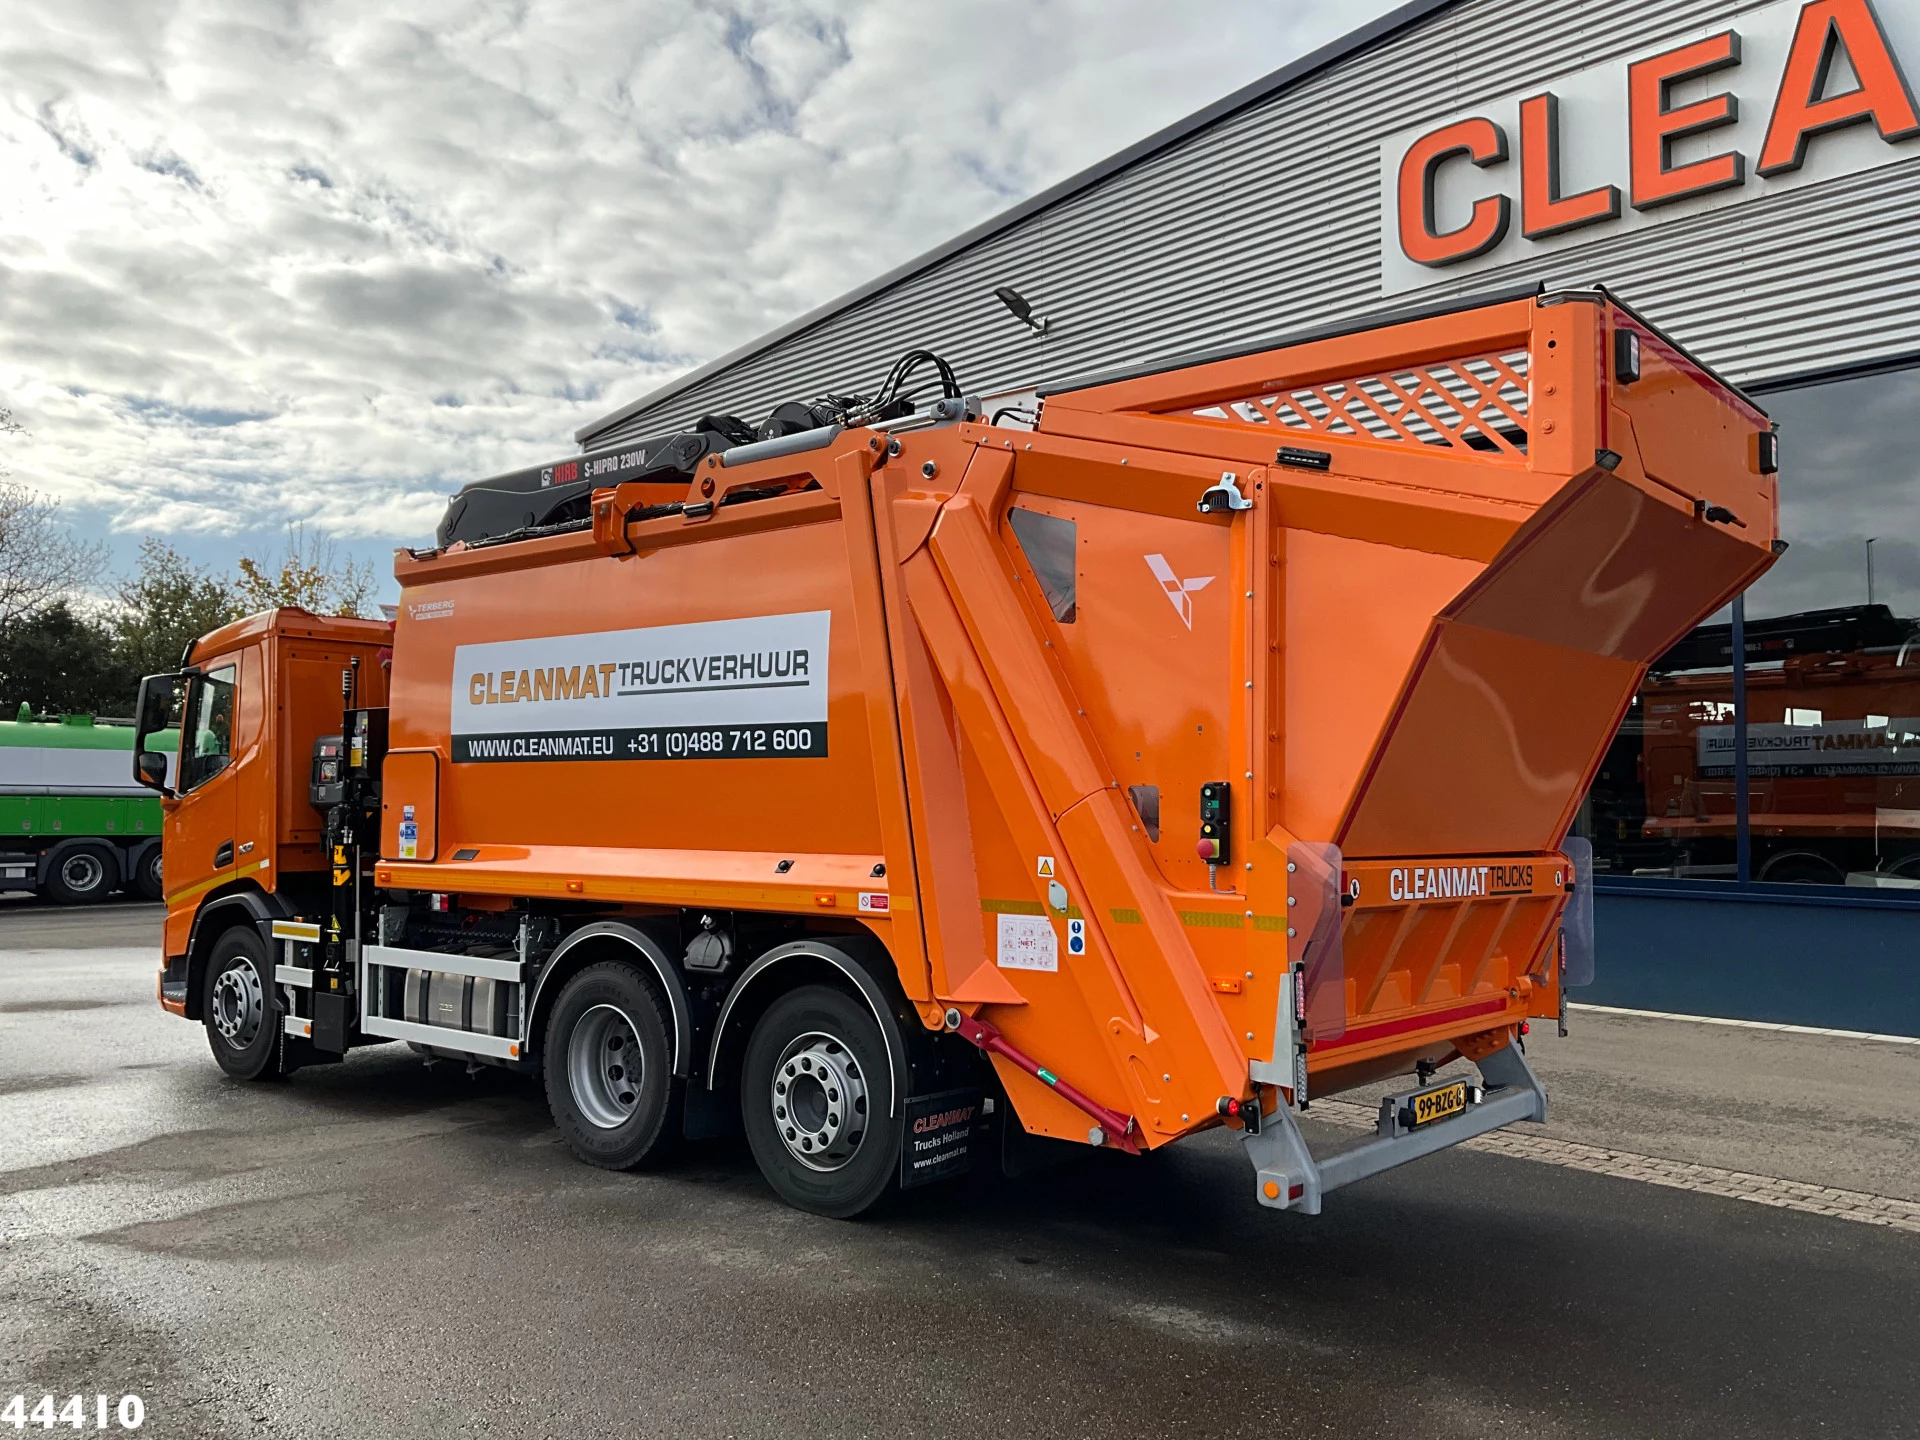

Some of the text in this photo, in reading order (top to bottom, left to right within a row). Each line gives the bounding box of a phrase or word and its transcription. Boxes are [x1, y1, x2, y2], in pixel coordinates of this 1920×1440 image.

[1397, 0, 1920, 268] CLEA
[584, 455, 618, 477] S-HIPRO
[620, 449, 646, 469] 230W
[417, 600, 455, 612] TERBERG
[469, 649, 809, 705] CLEANMAT TRUCKVERHUUR
[468, 729, 811, 757] WWW.CLEANMAT.EU +31 (0)488 712 600
[1389, 865, 1533, 901] CLEANMAT TRUCKS
[913, 1106, 975, 1134] CLEANMAT
[914, 1127, 970, 1151] Trucks Holland
[913, 1145, 967, 1169] www.cleanmat.eu
